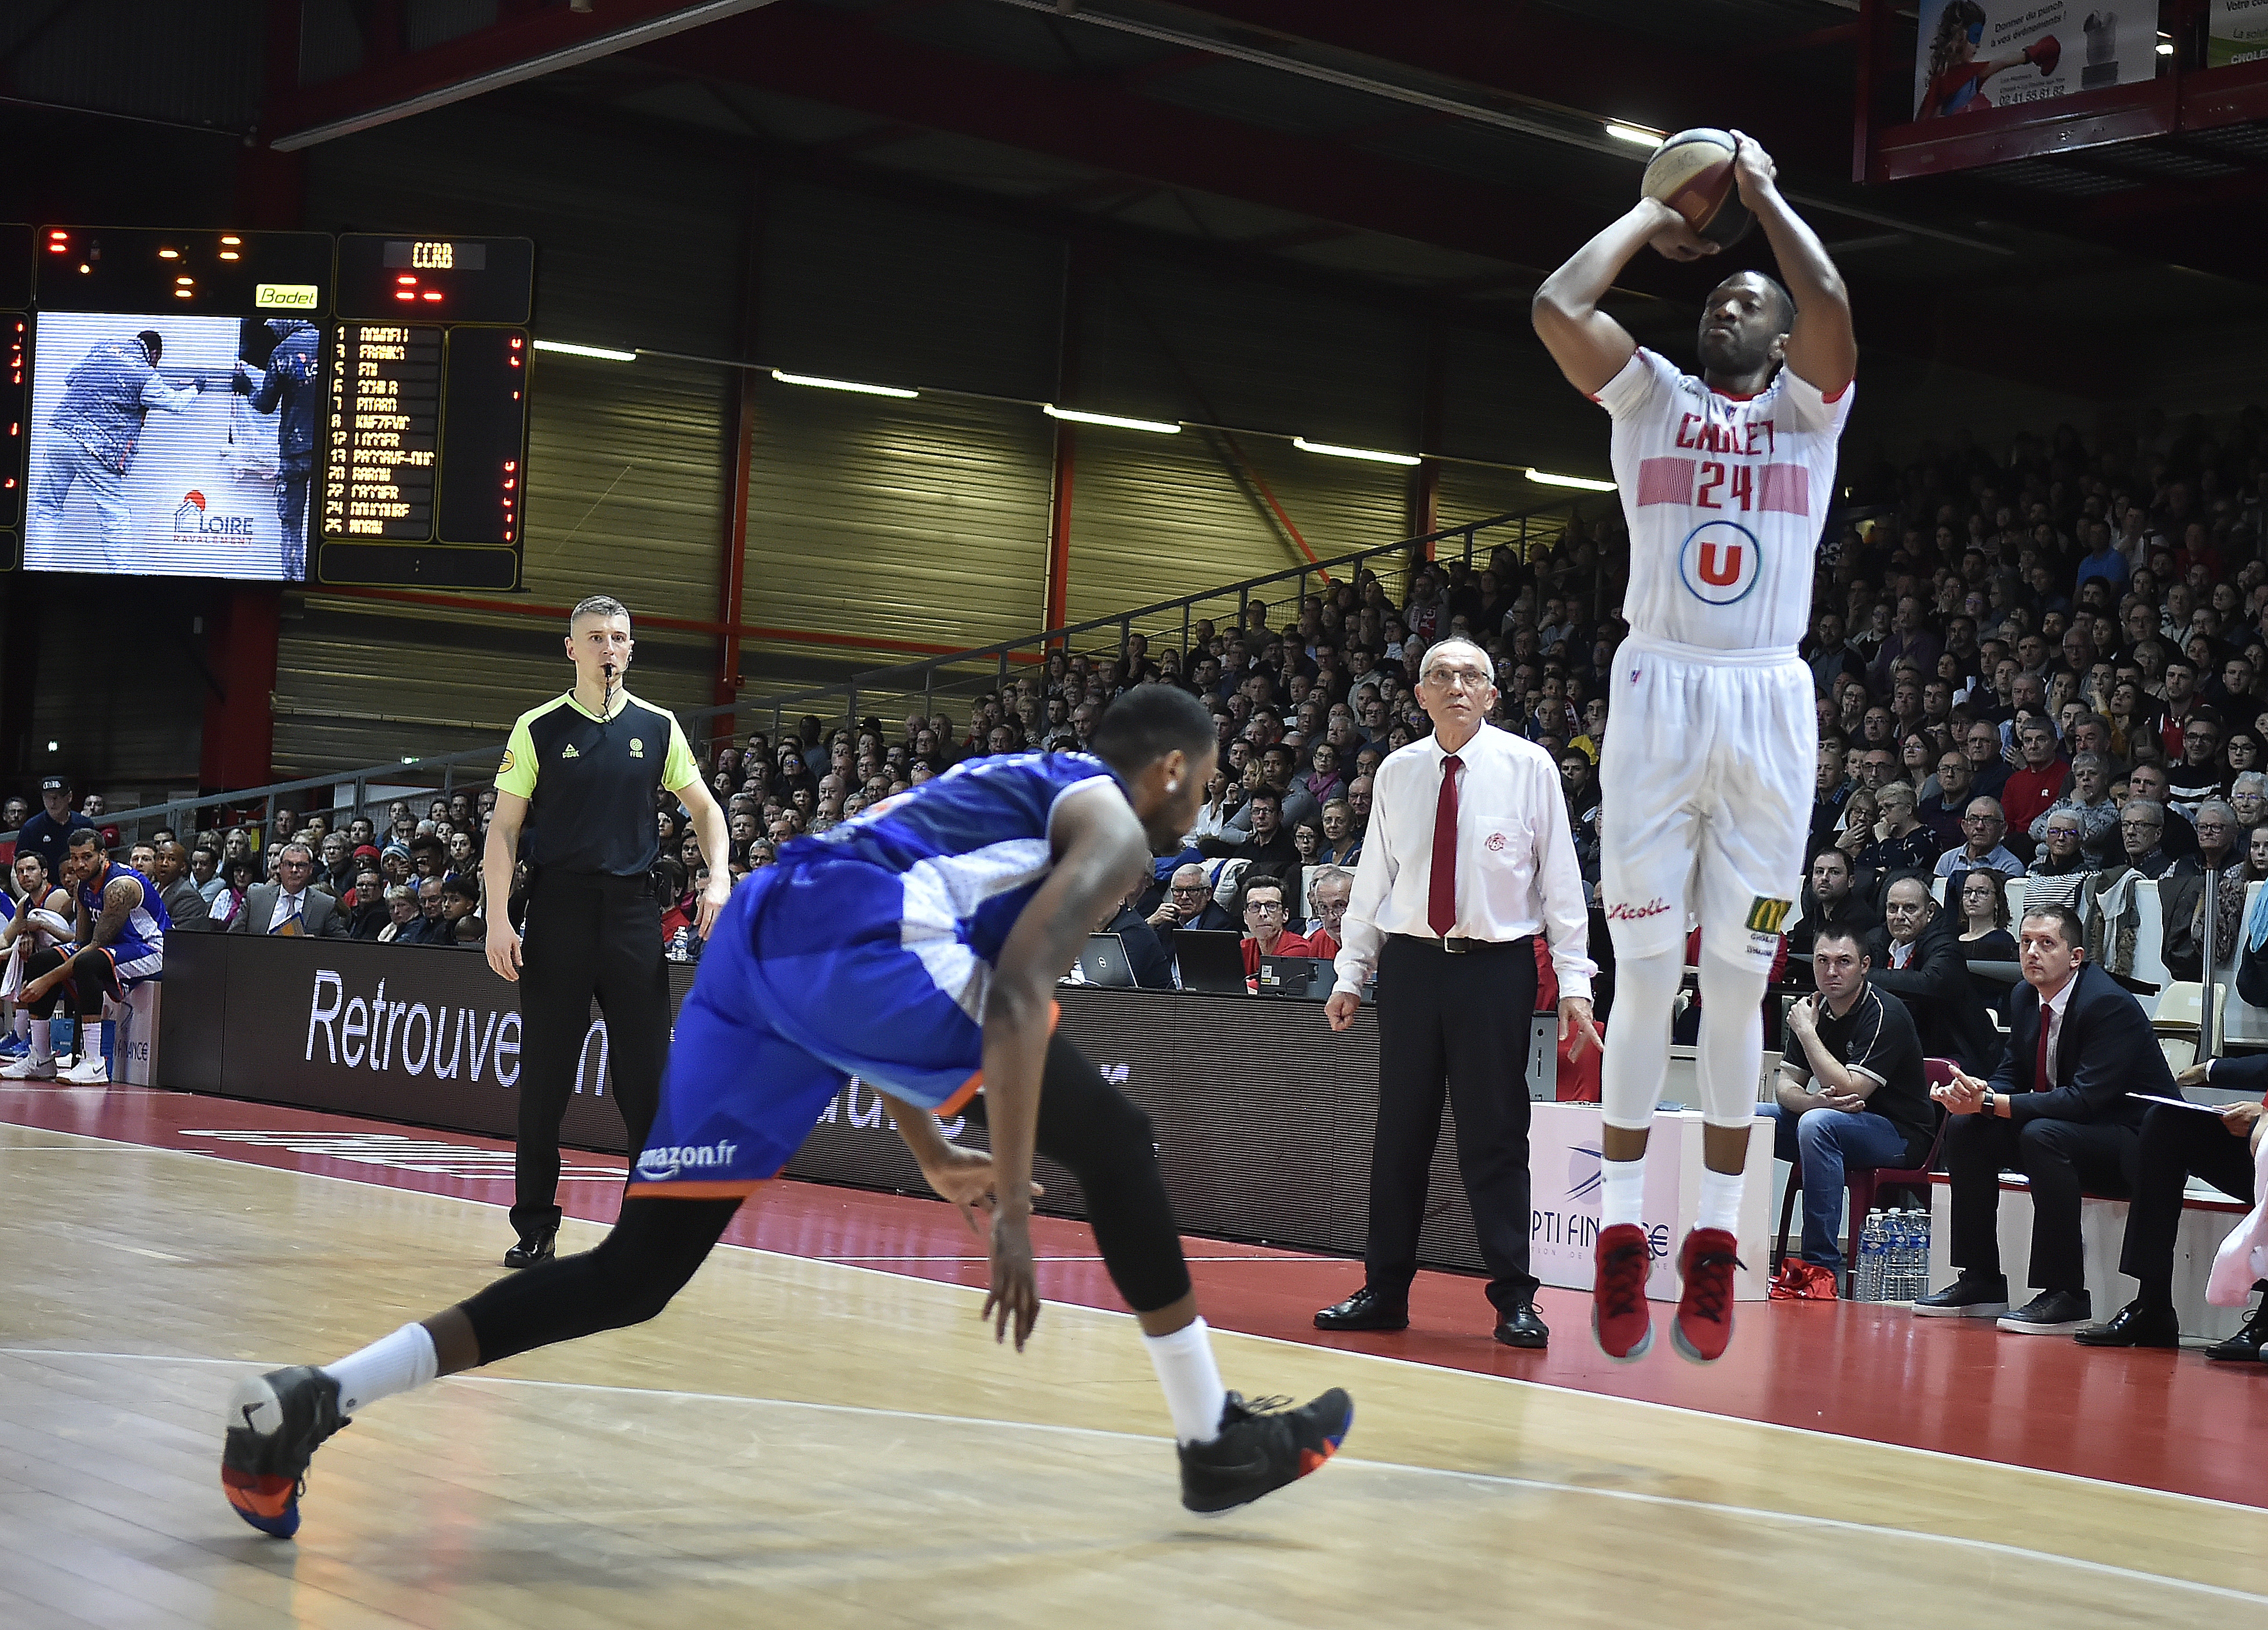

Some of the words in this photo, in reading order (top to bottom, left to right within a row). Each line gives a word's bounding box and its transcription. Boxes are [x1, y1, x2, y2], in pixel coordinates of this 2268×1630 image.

[1995, 15, 2024, 32] Donner
[2025, 11, 2036, 21] du
[2037, 1, 2064, 18] punch
[2231, 48, 2268, 64] CHOLE
[259, 288, 314, 305] Bodet
[1676, 412, 1775, 455] CHOLET
[1696, 461, 1752, 511] 24
[199, 513, 254, 535] LOIRE
[1699, 542, 1743, 587] U
[305, 969, 521, 1087] Retrouve
[1532, 1209, 1560, 1244] PTI
